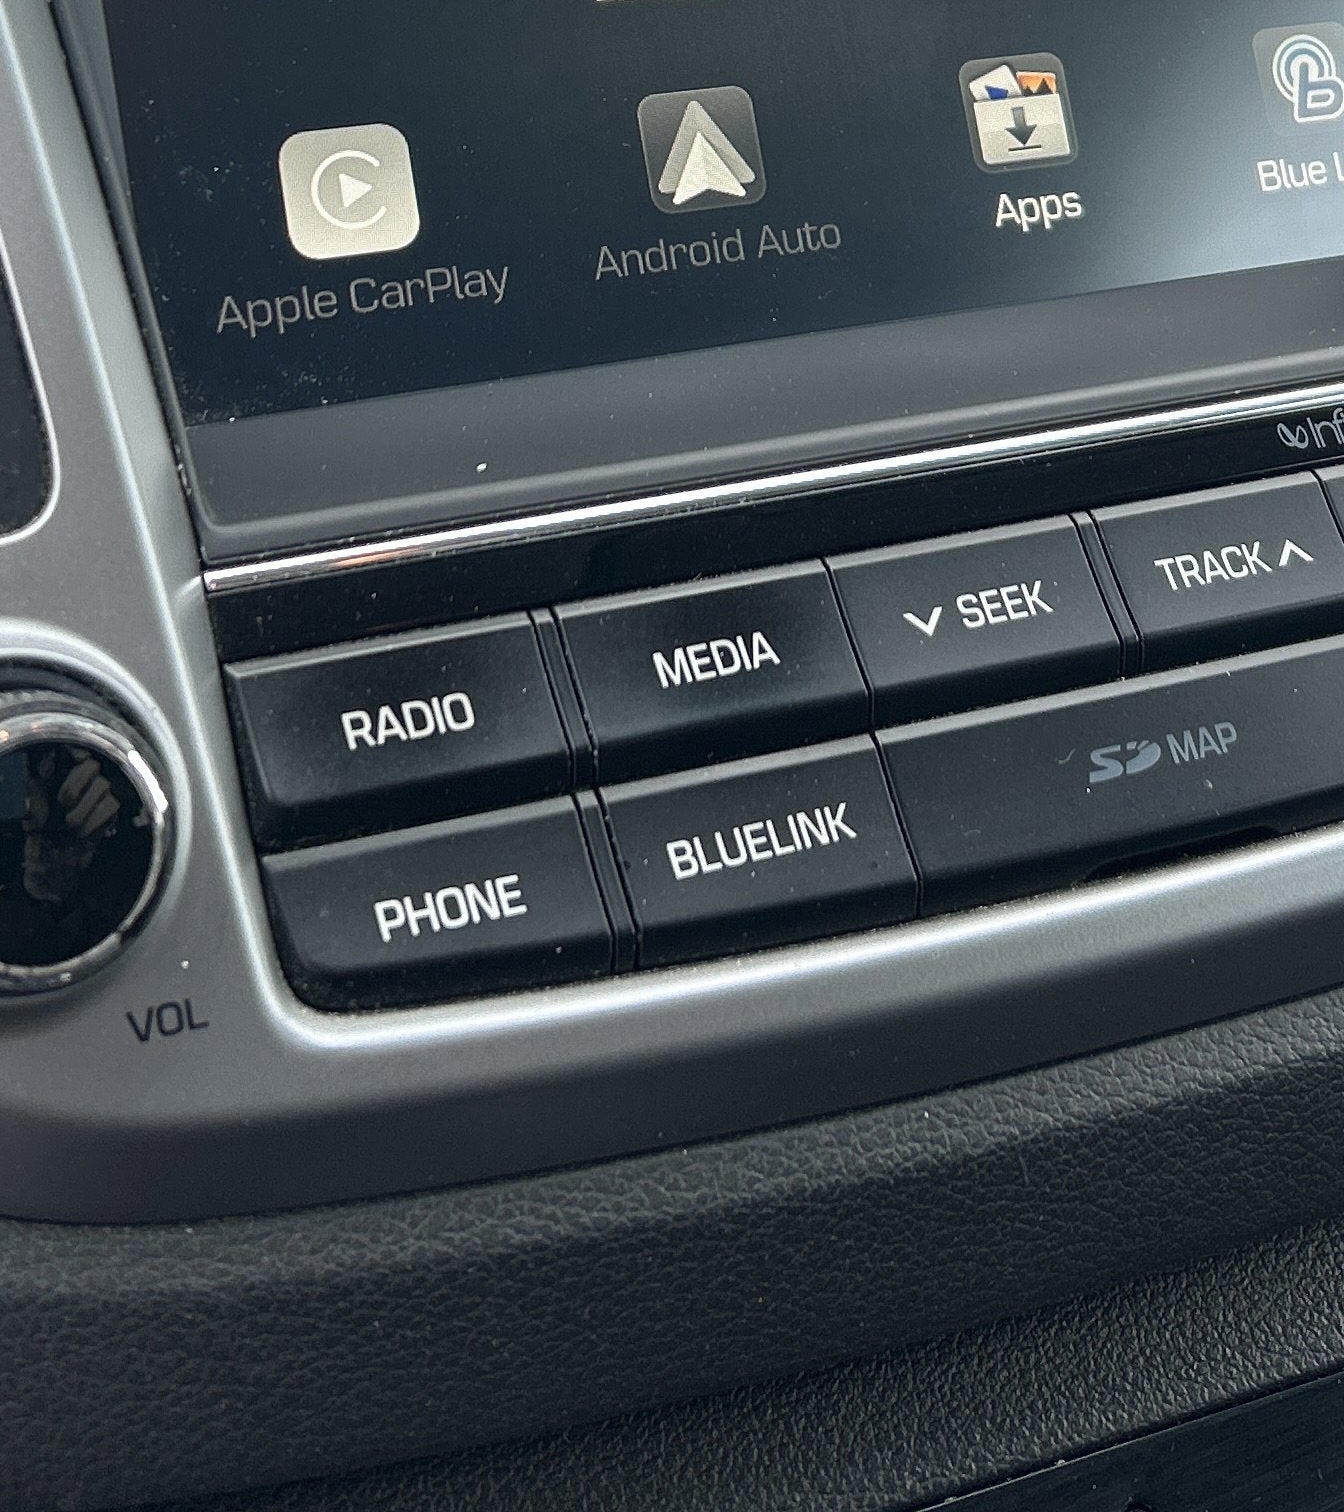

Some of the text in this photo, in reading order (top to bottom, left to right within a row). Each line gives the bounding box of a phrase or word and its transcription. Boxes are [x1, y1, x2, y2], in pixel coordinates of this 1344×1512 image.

[1257, 158, 1327, 192] Blue
[994, 191, 1083, 233] Apps
[594, 220, 842, 281] Android Auto
[216, 265, 510, 339] Apple CarPlay
[1153, 541, 1273, 593] TRACK
[954, 578, 1055, 632] SEEK
[652, 630, 782, 689] MEDIA
[341, 691, 477, 752] RADIO
[1167, 720, 1239, 763] MAP
[666, 801, 858, 881] BLUELINK
[374, 873, 528, 943] PHONE
[126, 998, 209, 1043] VOL
